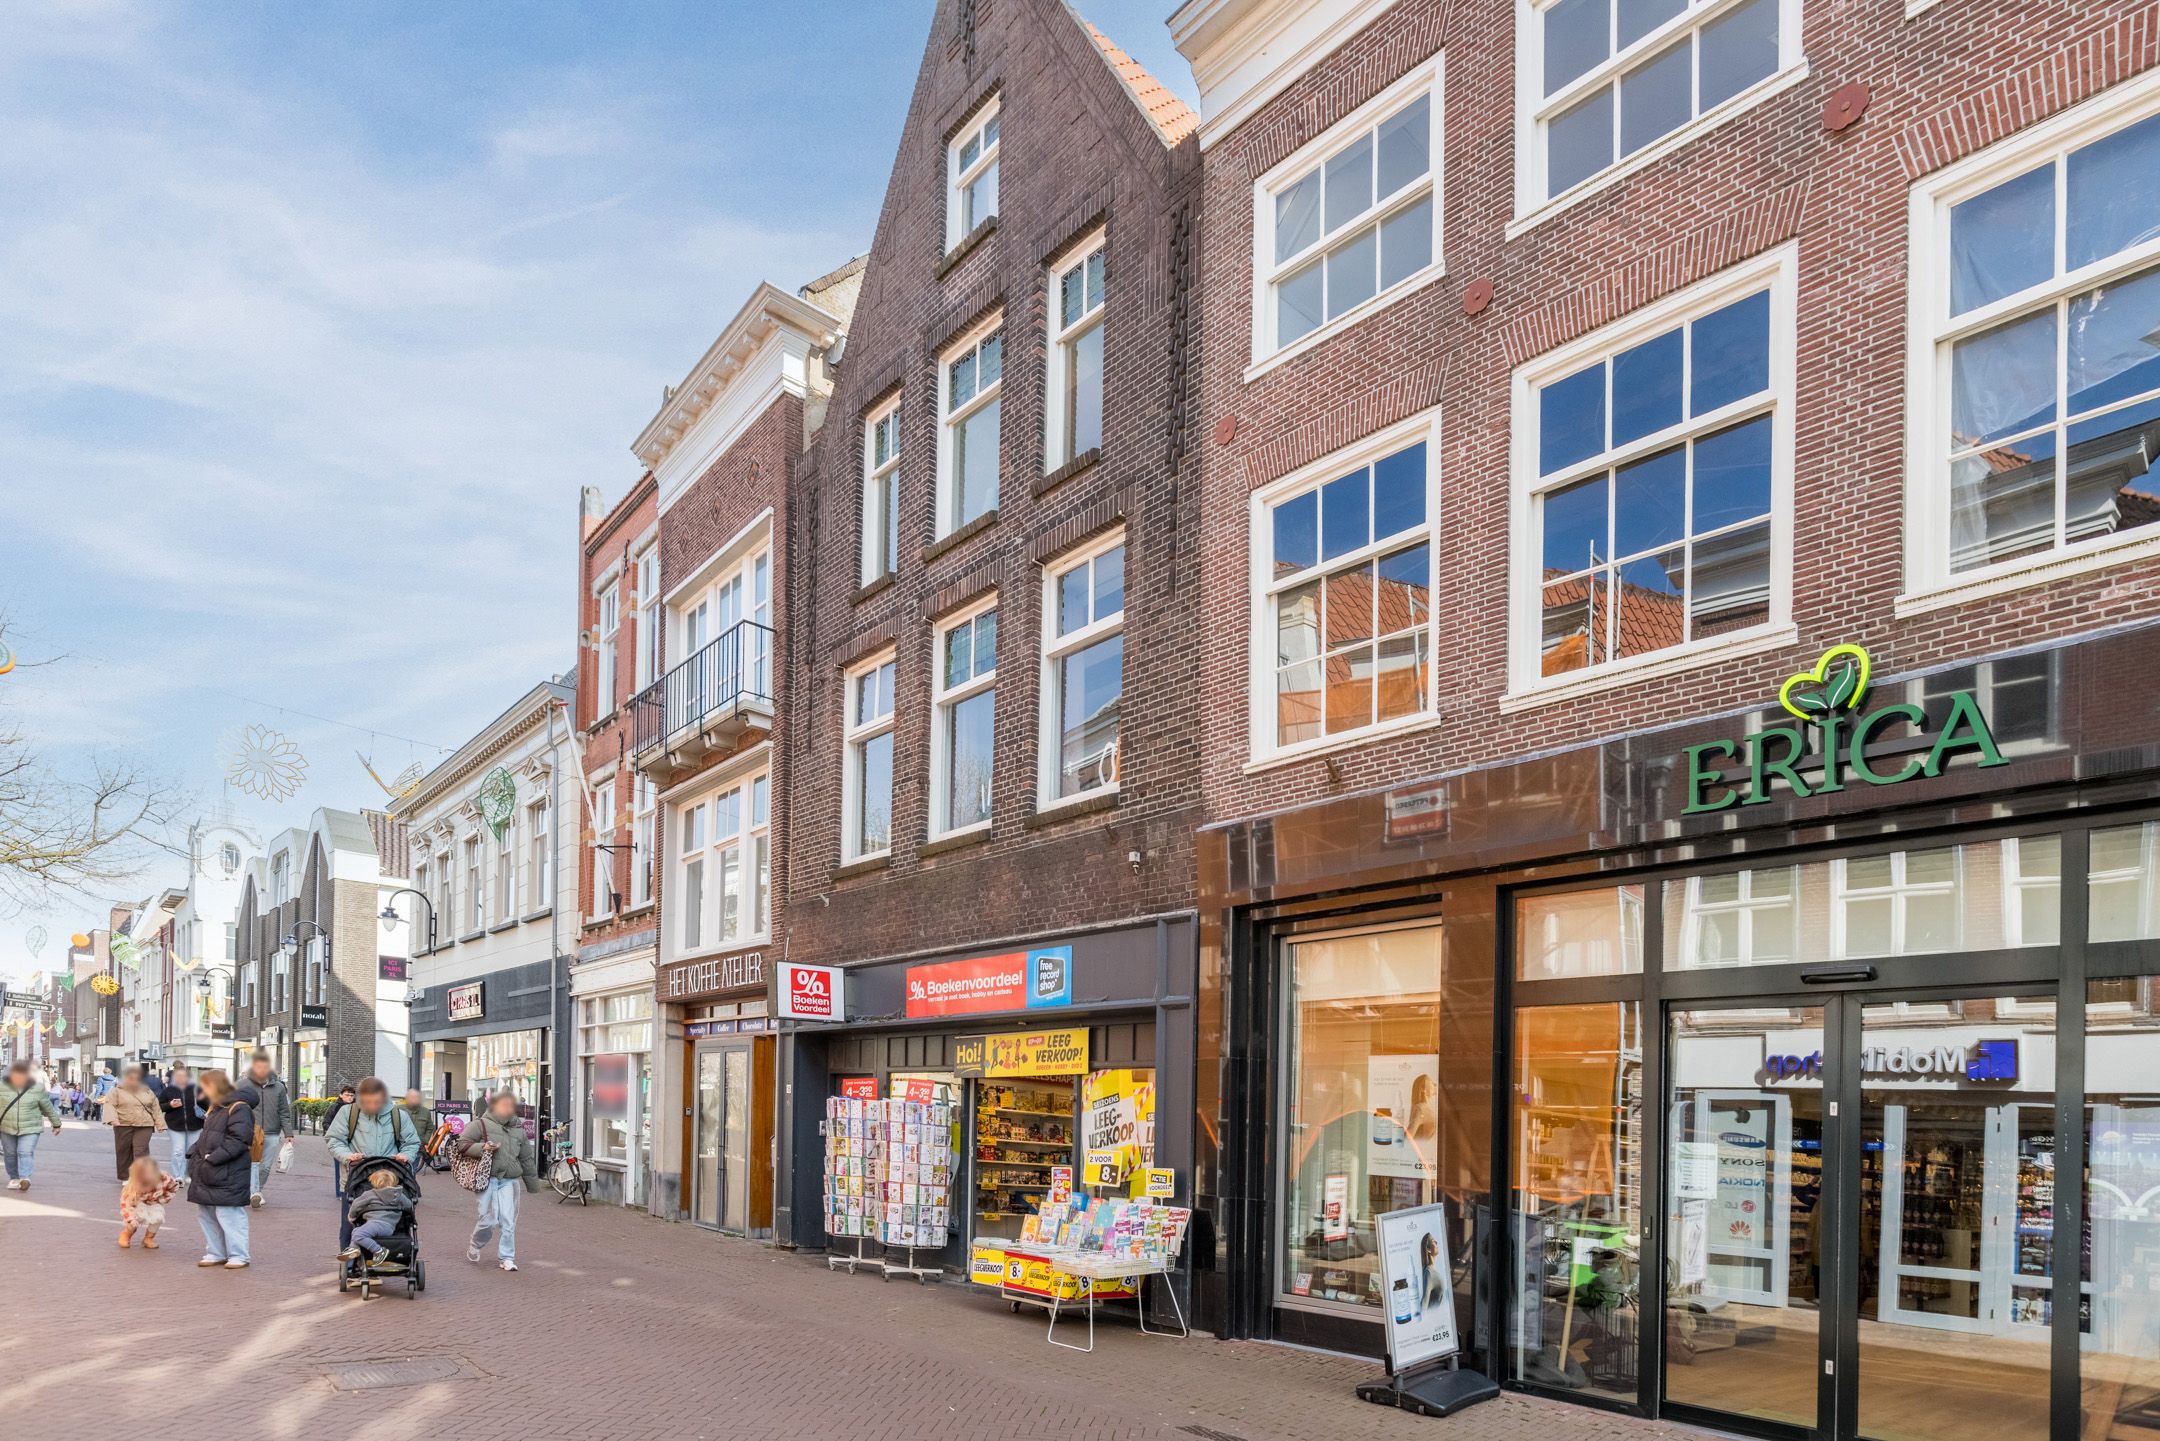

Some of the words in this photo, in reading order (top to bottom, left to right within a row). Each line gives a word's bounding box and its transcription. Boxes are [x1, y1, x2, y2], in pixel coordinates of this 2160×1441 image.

[1681, 692, 2011, 815] ERICA
[1039, 959, 1053, 971] free
[669, 967, 688, 997] HET
[688, 960, 720, 994] KOFFIE
[721, 951, 763, 989] ATELIER
[1039, 968, 1060, 981] record
[927, 970, 1023, 995] Boekenvoordeel
[793, 995, 830, 1006] Boeken
[793, 1003, 830, 1014] Voordeel
[303, 1012, 325, 1020] norah
[742, 1021, 763, 1030] Chocolate
[1047, 1033, 1071, 1048] LEEG
[956, 1042, 982, 1064] Hoi!
[1036, 1048, 1083, 1063] VERKOOP!
[1093, 1095, 1119, 1109] SEIZOENS
[1094, 1108, 1122, 1131] LEEG-
[1088, 1122, 1135, 1149] VERKOOP
[1151, 1175, 1167, 1183] ACTIE
[974, 1263, 1004, 1274] LEEGVERKOOP
[1432, 1330, 1450, 1342] €23,95
